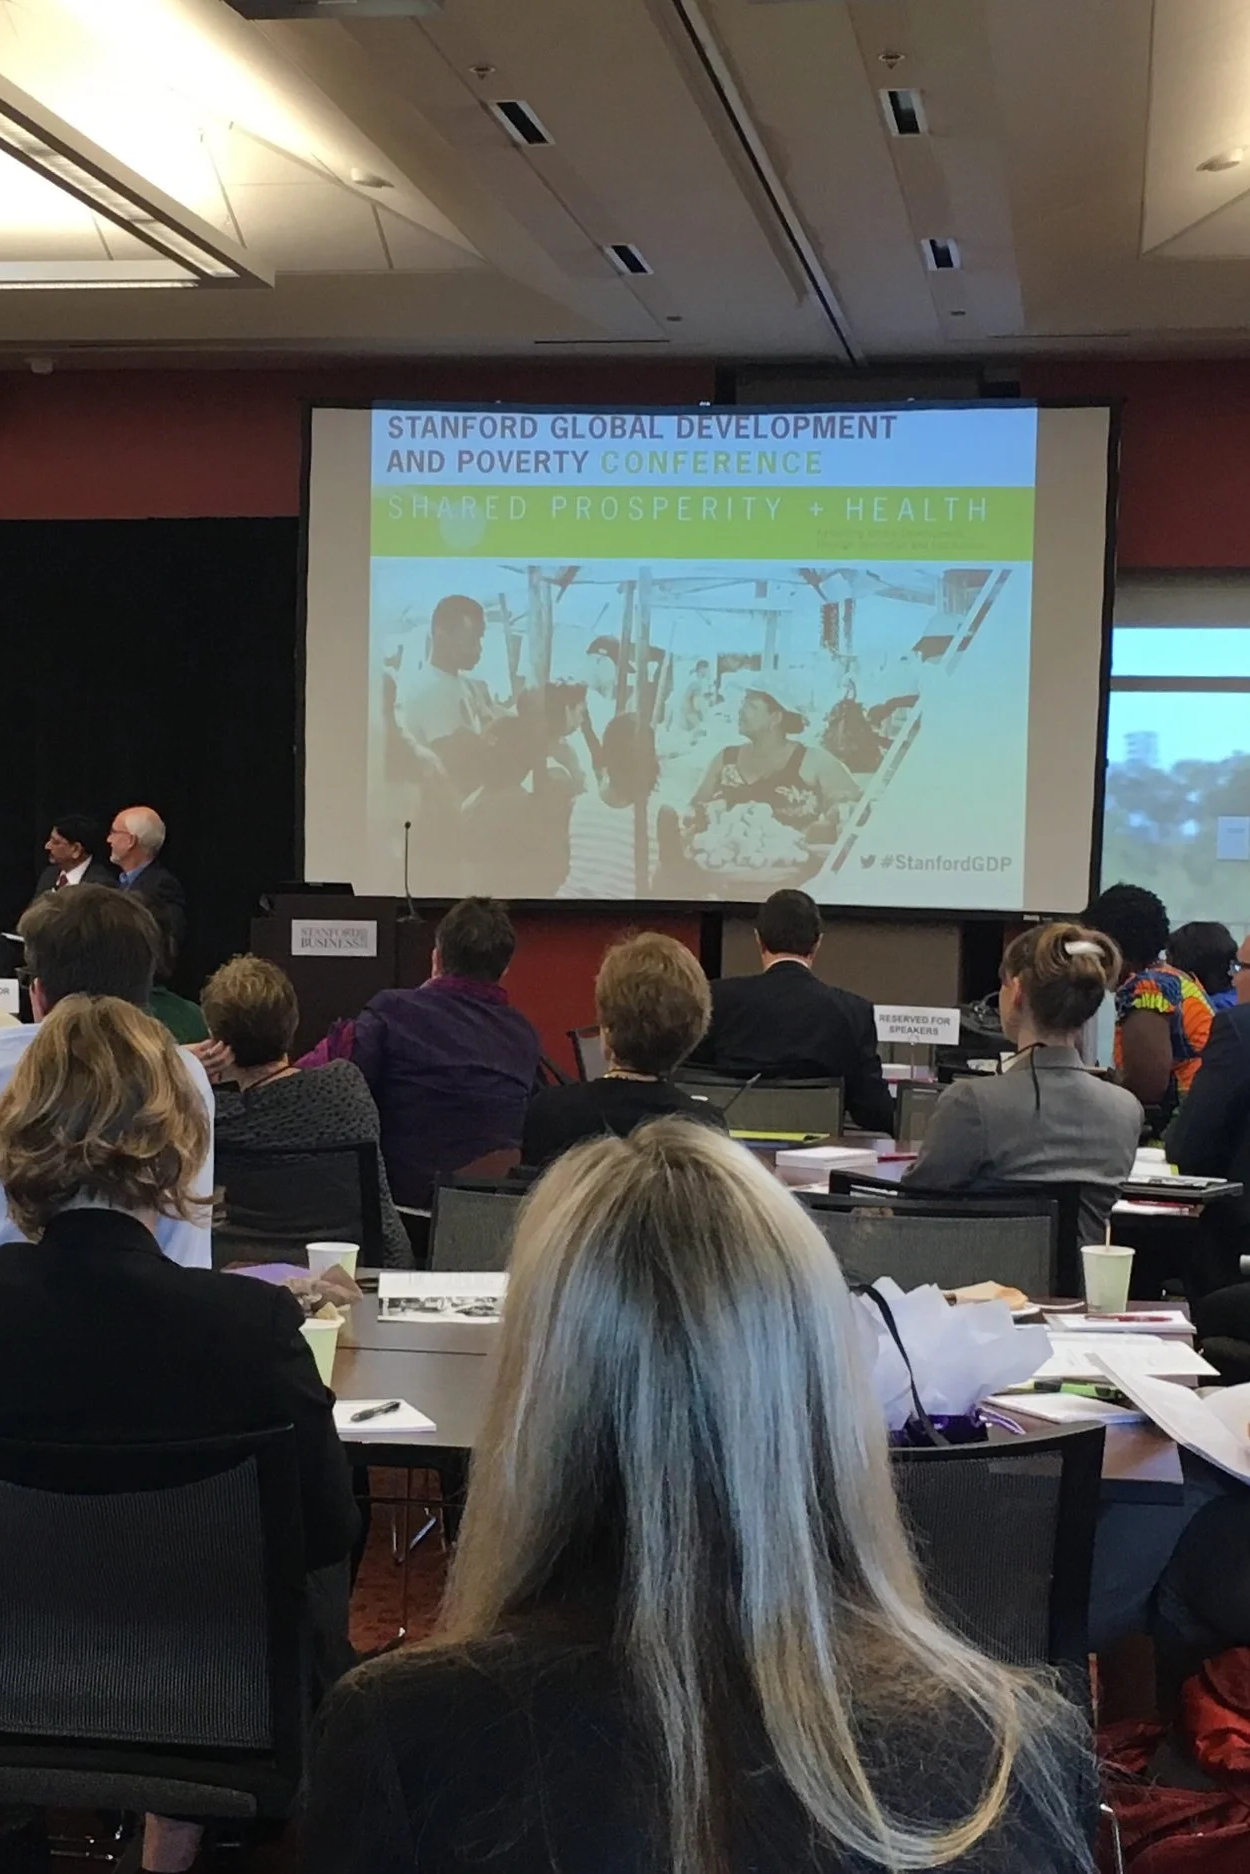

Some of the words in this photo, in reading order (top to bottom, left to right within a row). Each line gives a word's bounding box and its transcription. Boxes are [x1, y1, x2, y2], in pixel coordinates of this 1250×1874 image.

[388, 415, 538, 440] STANFORD
[551, 415, 664, 440] GLOBAL
[676, 414, 898, 440] DEVELOPMENT
[386, 449, 446, 474] AND
[457, 449, 590, 474] POVERTY
[601, 450, 823, 475] CONFERENCE
[388, 495, 527, 521] SHARED
[551, 495, 782, 522] PROSPERITY
[809, 501, 824, 517] +
[846, 496, 988, 522] HEALTH
[880, 854, 1013, 873] #StanfordGDP
[300, 938, 360, 949] BUSINESS
[878, 1013, 930, 1025] RESERVED
[931, 1016, 951, 1026] FOR
[888, 1025, 939, 1036] SPEAKERS
